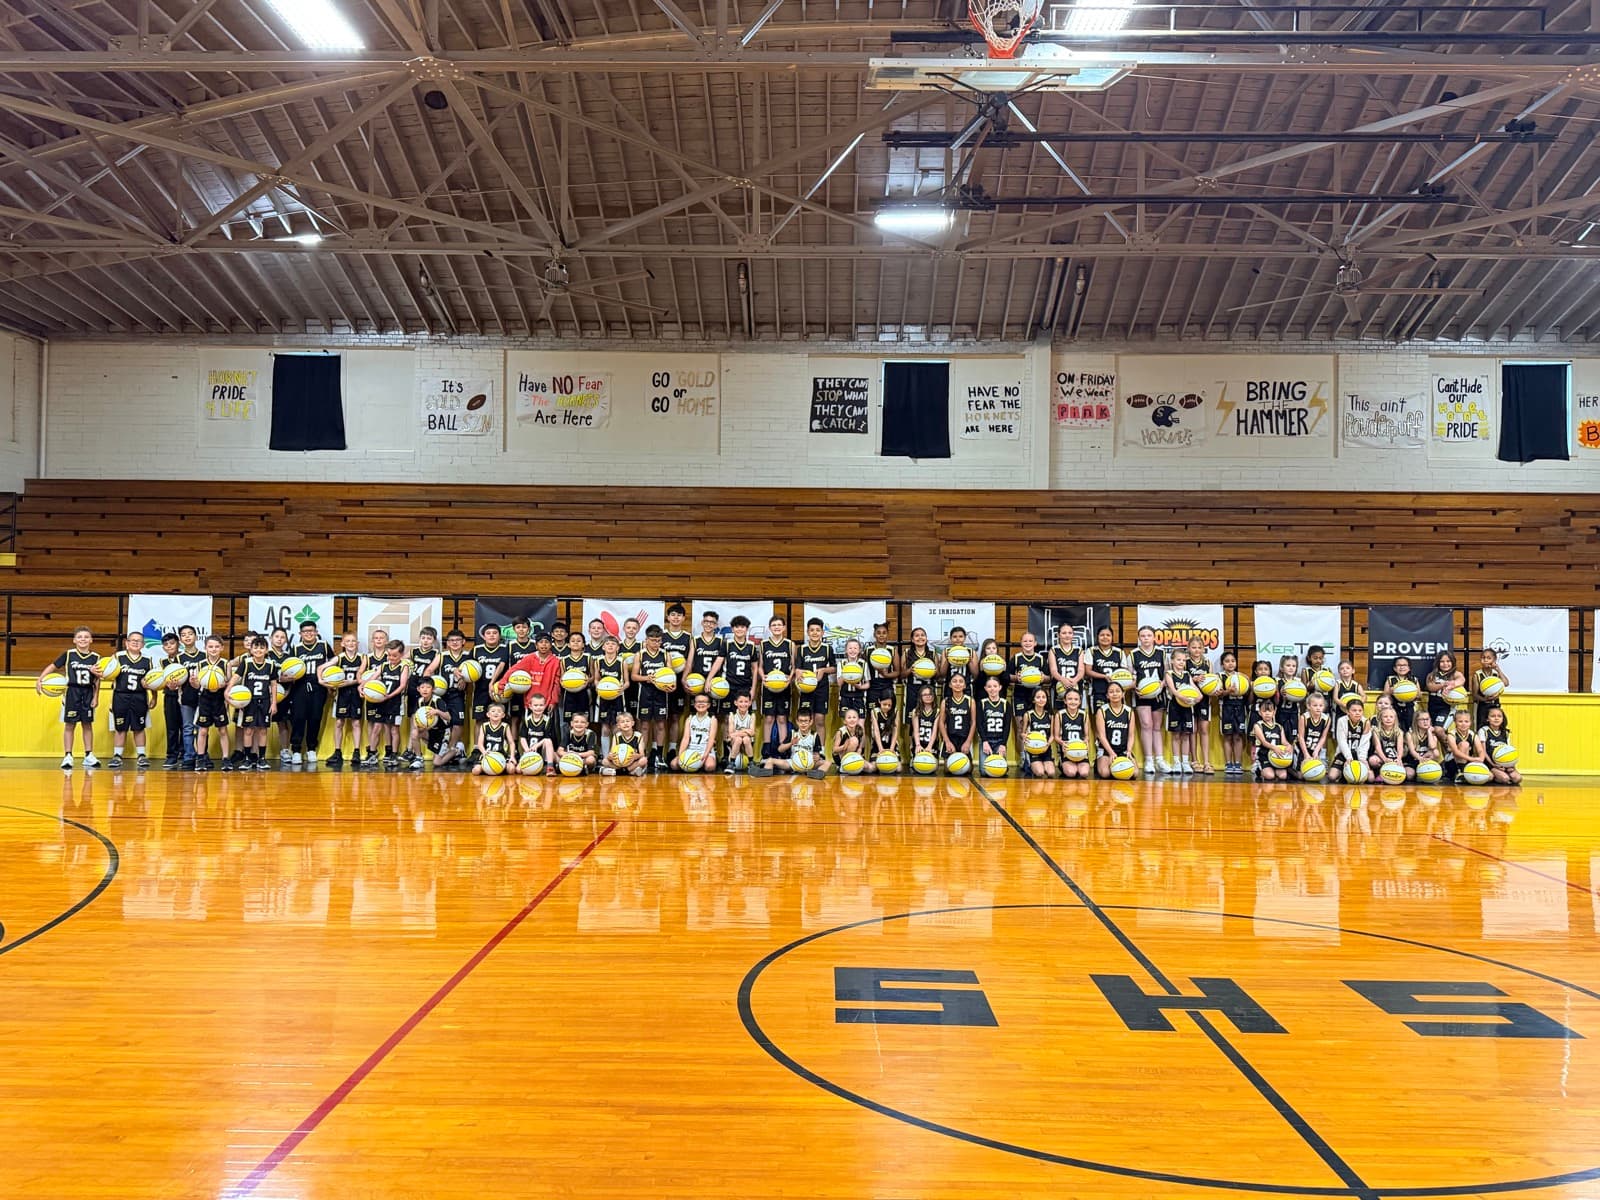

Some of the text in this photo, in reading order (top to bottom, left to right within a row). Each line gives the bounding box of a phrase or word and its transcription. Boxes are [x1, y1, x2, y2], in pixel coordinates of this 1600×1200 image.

[519, 373, 604, 395] Have NO Fear
[652, 371, 715, 388] GO GOLD
[816, 378, 847, 389] THEY
[1057, 372, 1115, 386] ON FRIDAY
[1460, 377, 1482, 393] Hide
[212, 385, 247, 400] PRIDE
[673, 388, 687, 398] or
[815, 390, 868, 402] STOP WHAT
[967, 386, 1020, 398] HAVE NO
[1060, 386, 1083, 398] We
[1246, 381, 1307, 401] BRING
[651, 396, 716, 416] GO HOME
[967, 399, 1021, 411] FEAR THE
[1156, 393, 1176, 405] GO
[1257, 399, 1293, 410] THE
[1346, 394, 1370, 412] This
[534, 409, 593, 426] Are Here
[813, 404, 845, 417] THEY
[965, 411, 1020, 422] HORNETS
[428, 414, 458, 431] BALL
[822, 417, 856, 430] CATCH
[965, 424, 1013, 434] ARE HERE
[1236, 407, 1309, 436] HAMMER
[1446, 422, 1479, 439] PRIDE
[264, 605, 292, 631] AG
[1373, 641, 1449, 654] PROVEN
[1514, 645, 1565, 653] MAXWELL
[306, 660, 316, 674] 11
[702, 656, 712, 671] 5
[735, 660, 746, 676] 2
[75, 670, 90, 684] 13
[485, 664, 496, 679] 8
[127, 675, 137, 690] 5
[253, 681, 263, 696] 2
[385, 680, 392, 694] 7
[954, 715, 963, 730] 2
[986, 717, 1004, 732] 22
[695, 733, 703, 745] 7
[1111, 729, 1121, 745] 8
